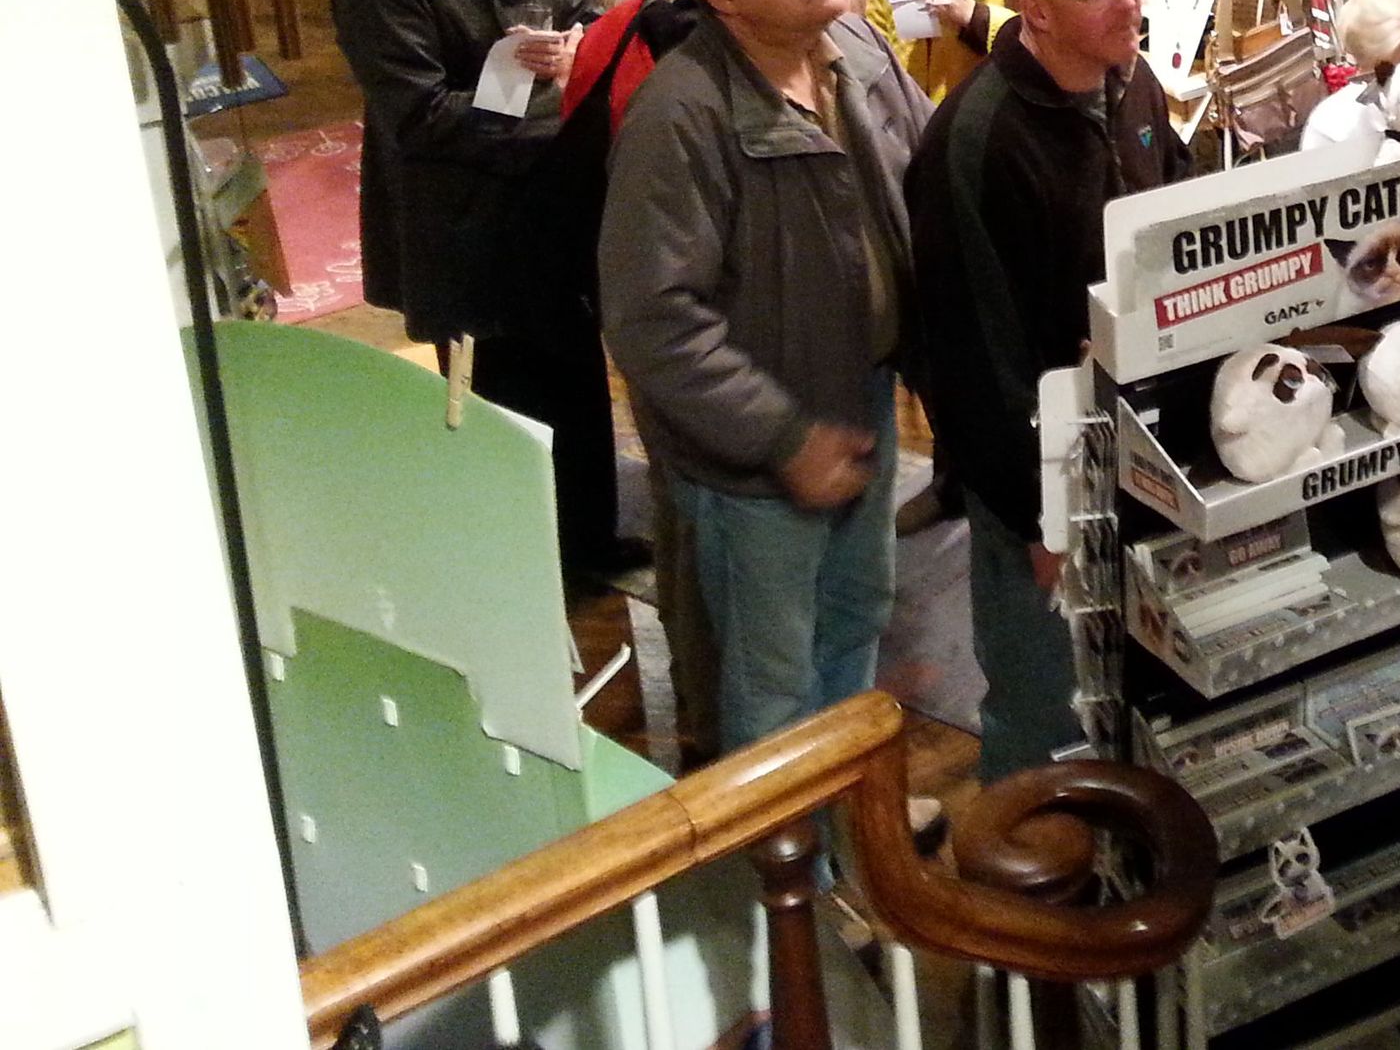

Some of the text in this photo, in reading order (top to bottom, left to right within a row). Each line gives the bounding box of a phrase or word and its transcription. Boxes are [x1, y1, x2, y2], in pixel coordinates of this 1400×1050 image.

[1172, 196, 1330, 276] GRUMPY
[1163, 251, 1314, 322] THINK GRUMPY
[1264, 301, 1311, 326] GANZ
